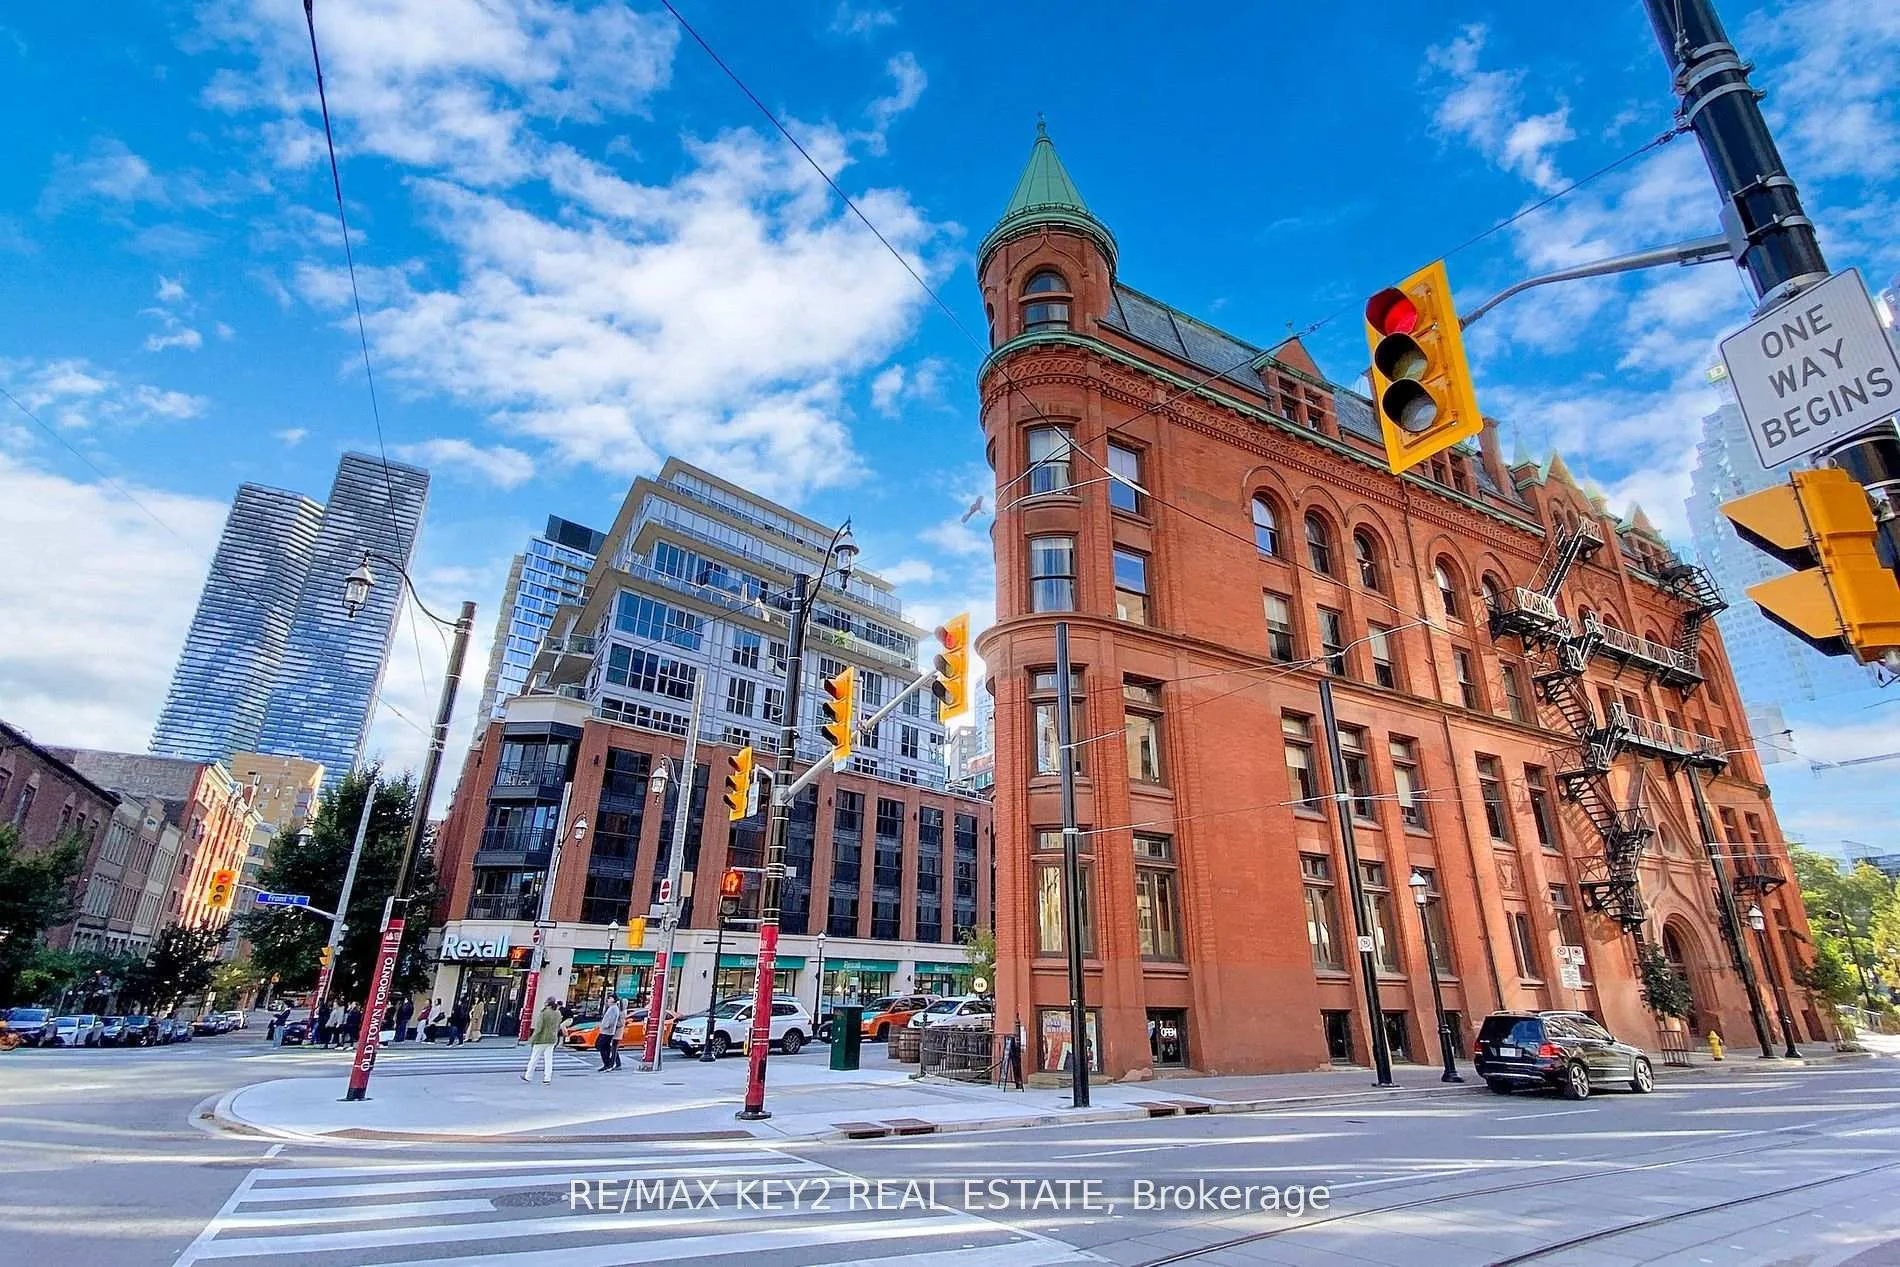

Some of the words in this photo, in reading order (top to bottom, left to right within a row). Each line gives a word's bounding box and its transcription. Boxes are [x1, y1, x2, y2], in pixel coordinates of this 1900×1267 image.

[1761, 303, 1832, 358] ONE
[1768, 338, 1844, 398] WAY
[1760, 367, 1893, 448] BEGINS
[267, 894, 287, 902] Front
[441, 934, 510, 959] Rexall
[375, 956, 395, 1006] TORONTO
[367, 1008, 382, 1043] TOWN
[361, 1045, 374, 1072] OLD
